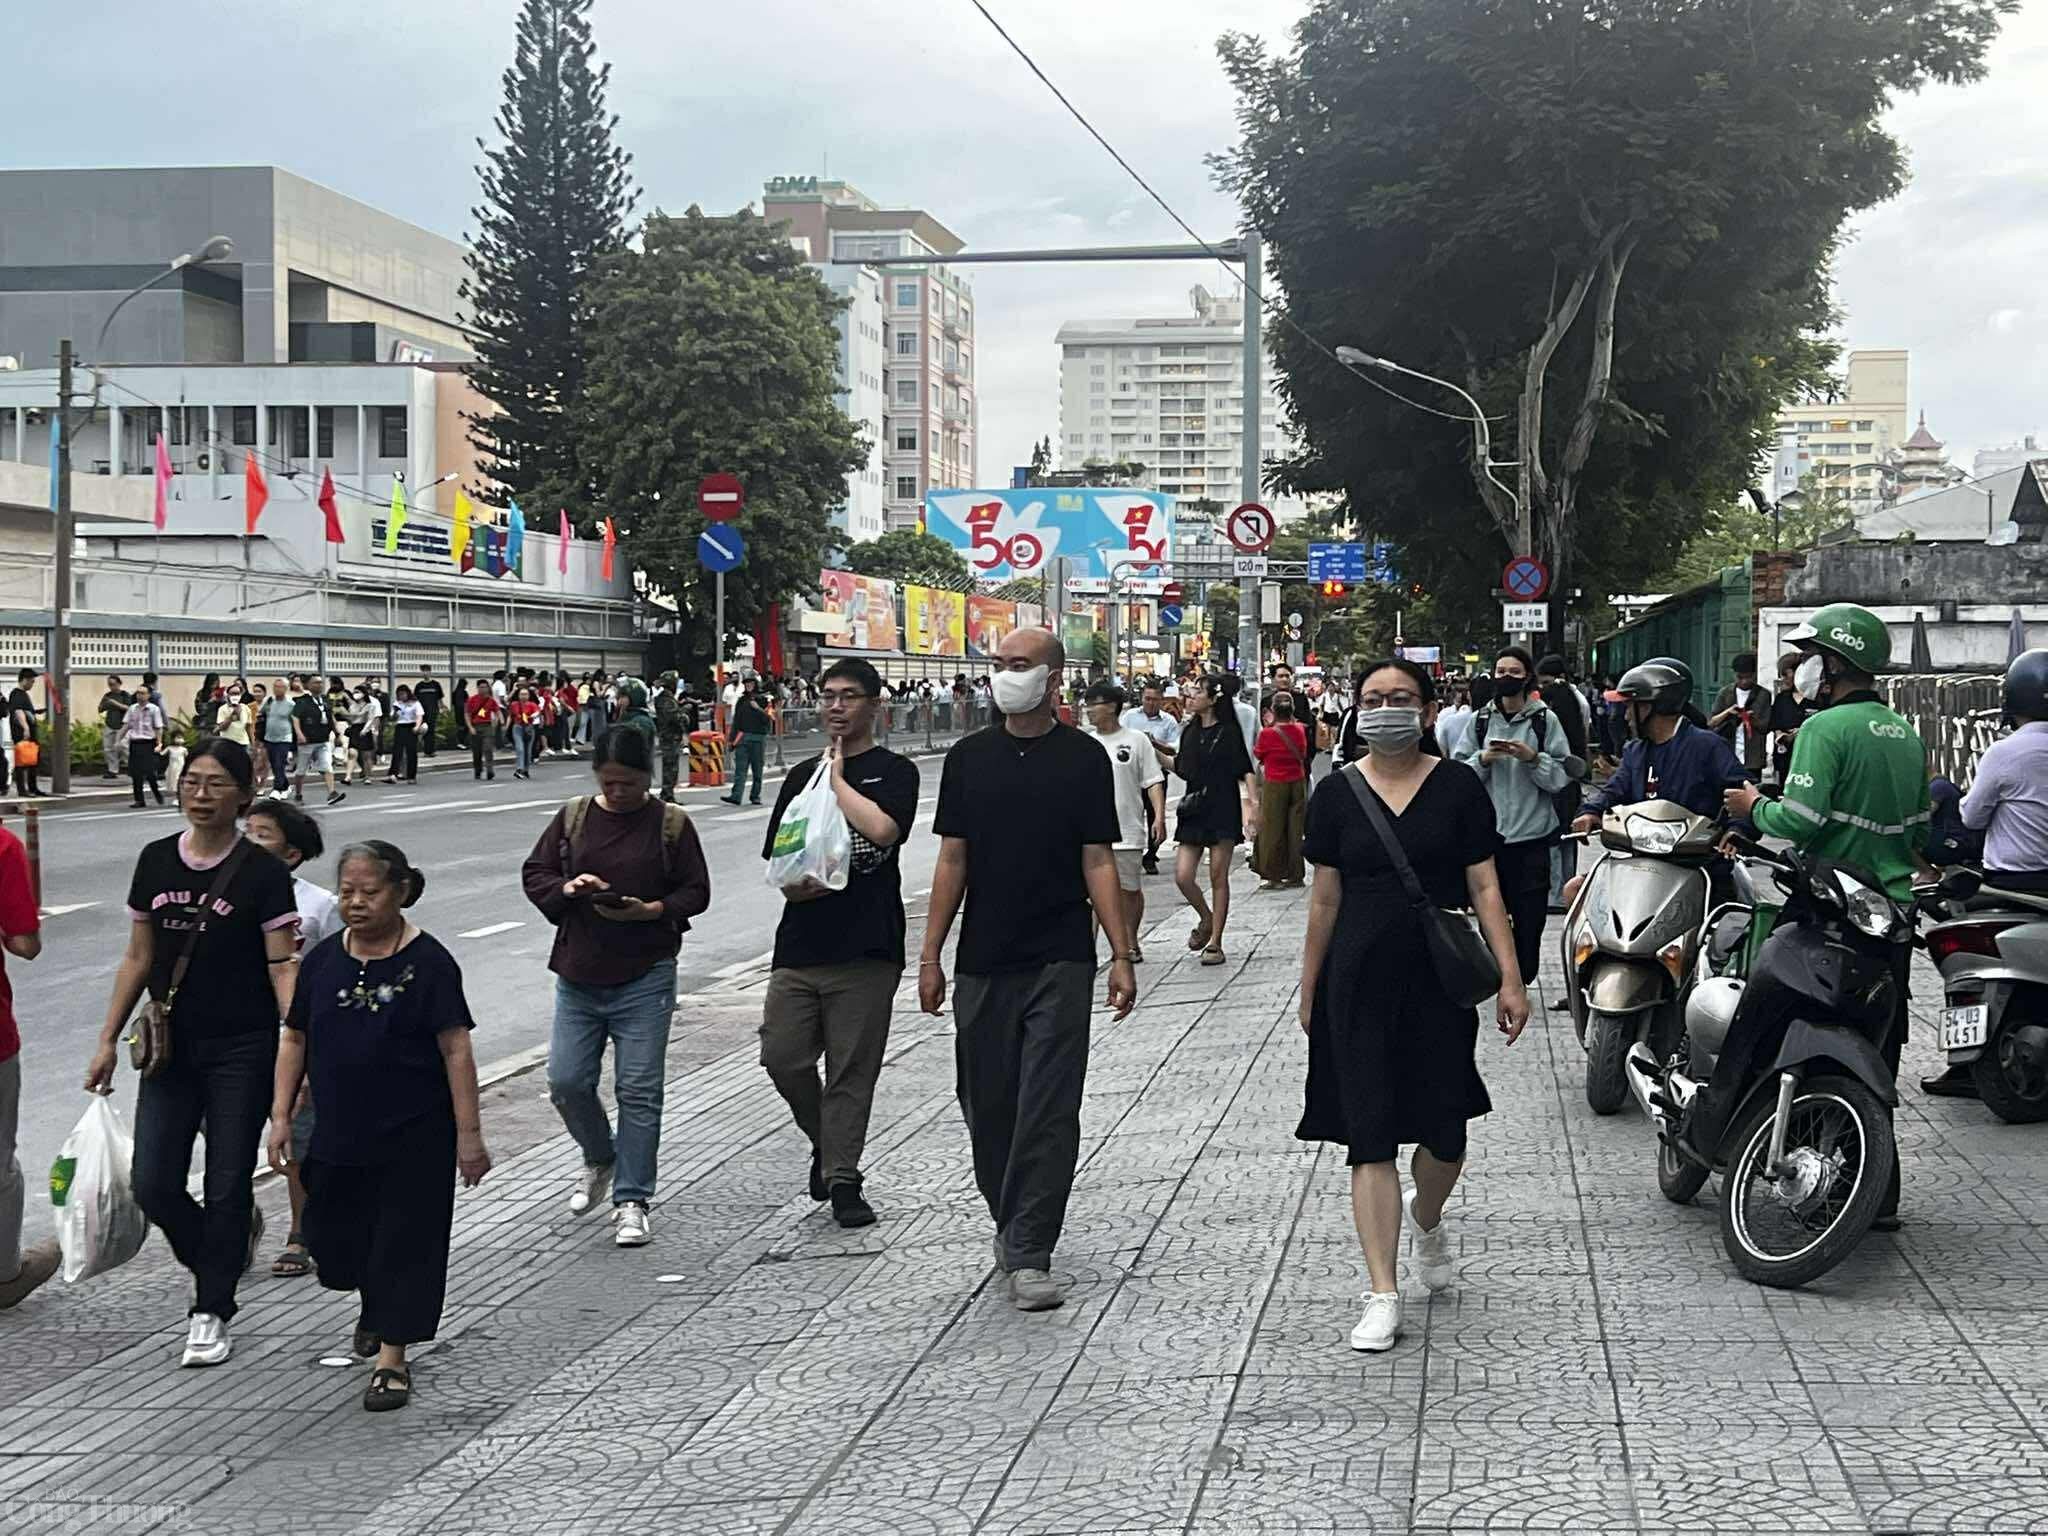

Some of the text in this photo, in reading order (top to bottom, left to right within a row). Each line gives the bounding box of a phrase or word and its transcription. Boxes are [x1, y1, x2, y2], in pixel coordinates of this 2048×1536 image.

[1238, 560, 1264, 572] 120 m
[1830, 627, 1866, 651] Grab
[1868, 719, 1906, 740] Grab
